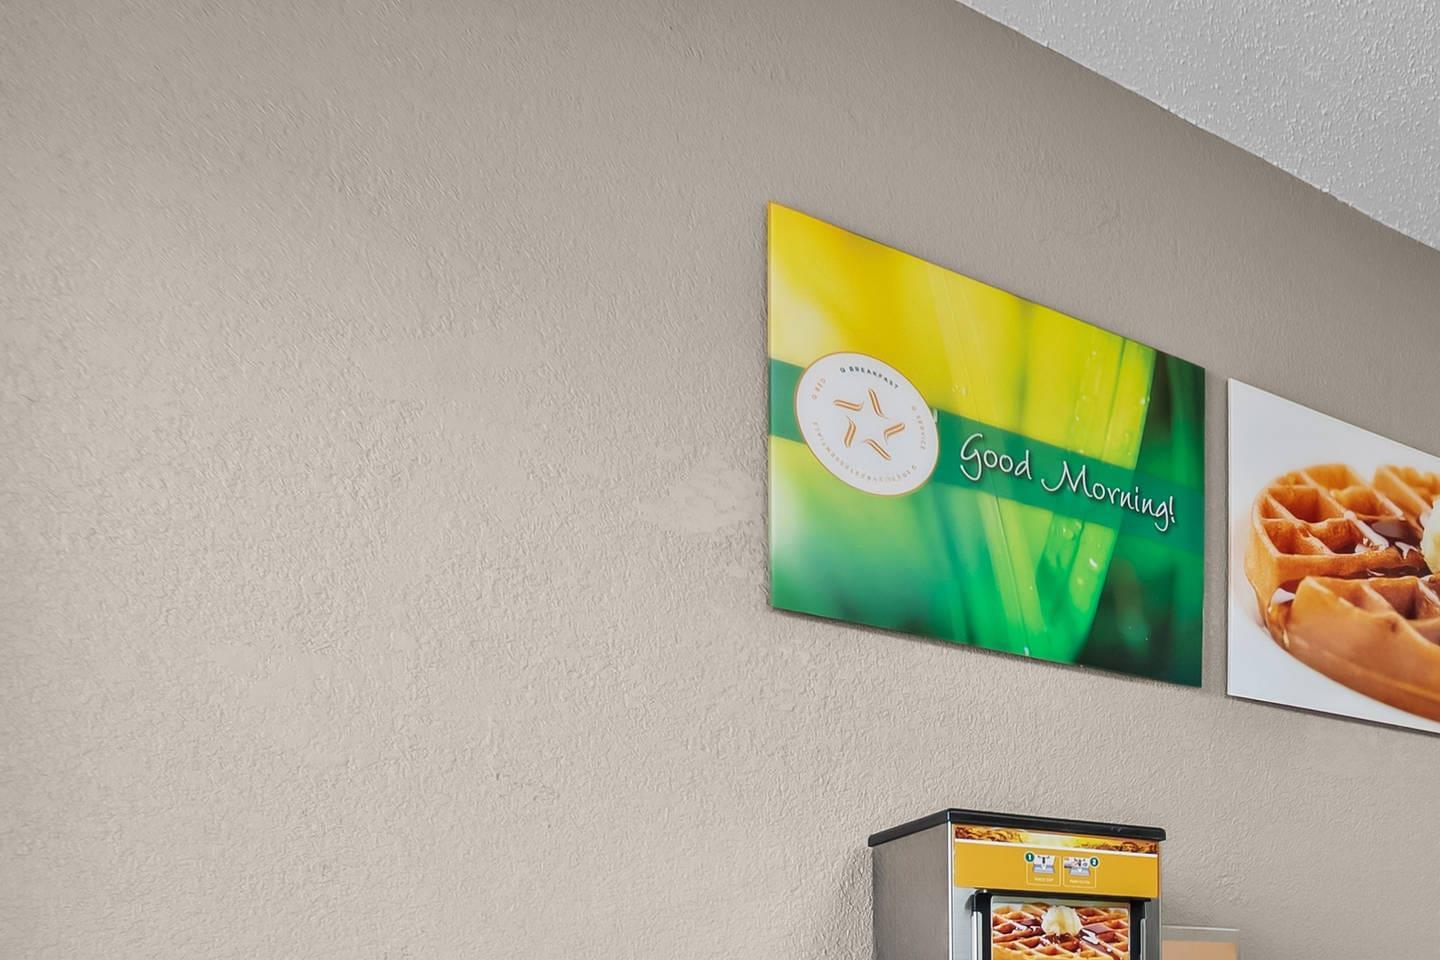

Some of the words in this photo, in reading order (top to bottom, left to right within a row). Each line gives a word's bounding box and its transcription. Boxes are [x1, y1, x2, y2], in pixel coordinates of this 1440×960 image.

[849, 366, 899, 389] BREAKFAST
[960, 432, 1032, 481] Good
[1040, 460, 1176, 532] Morning!
